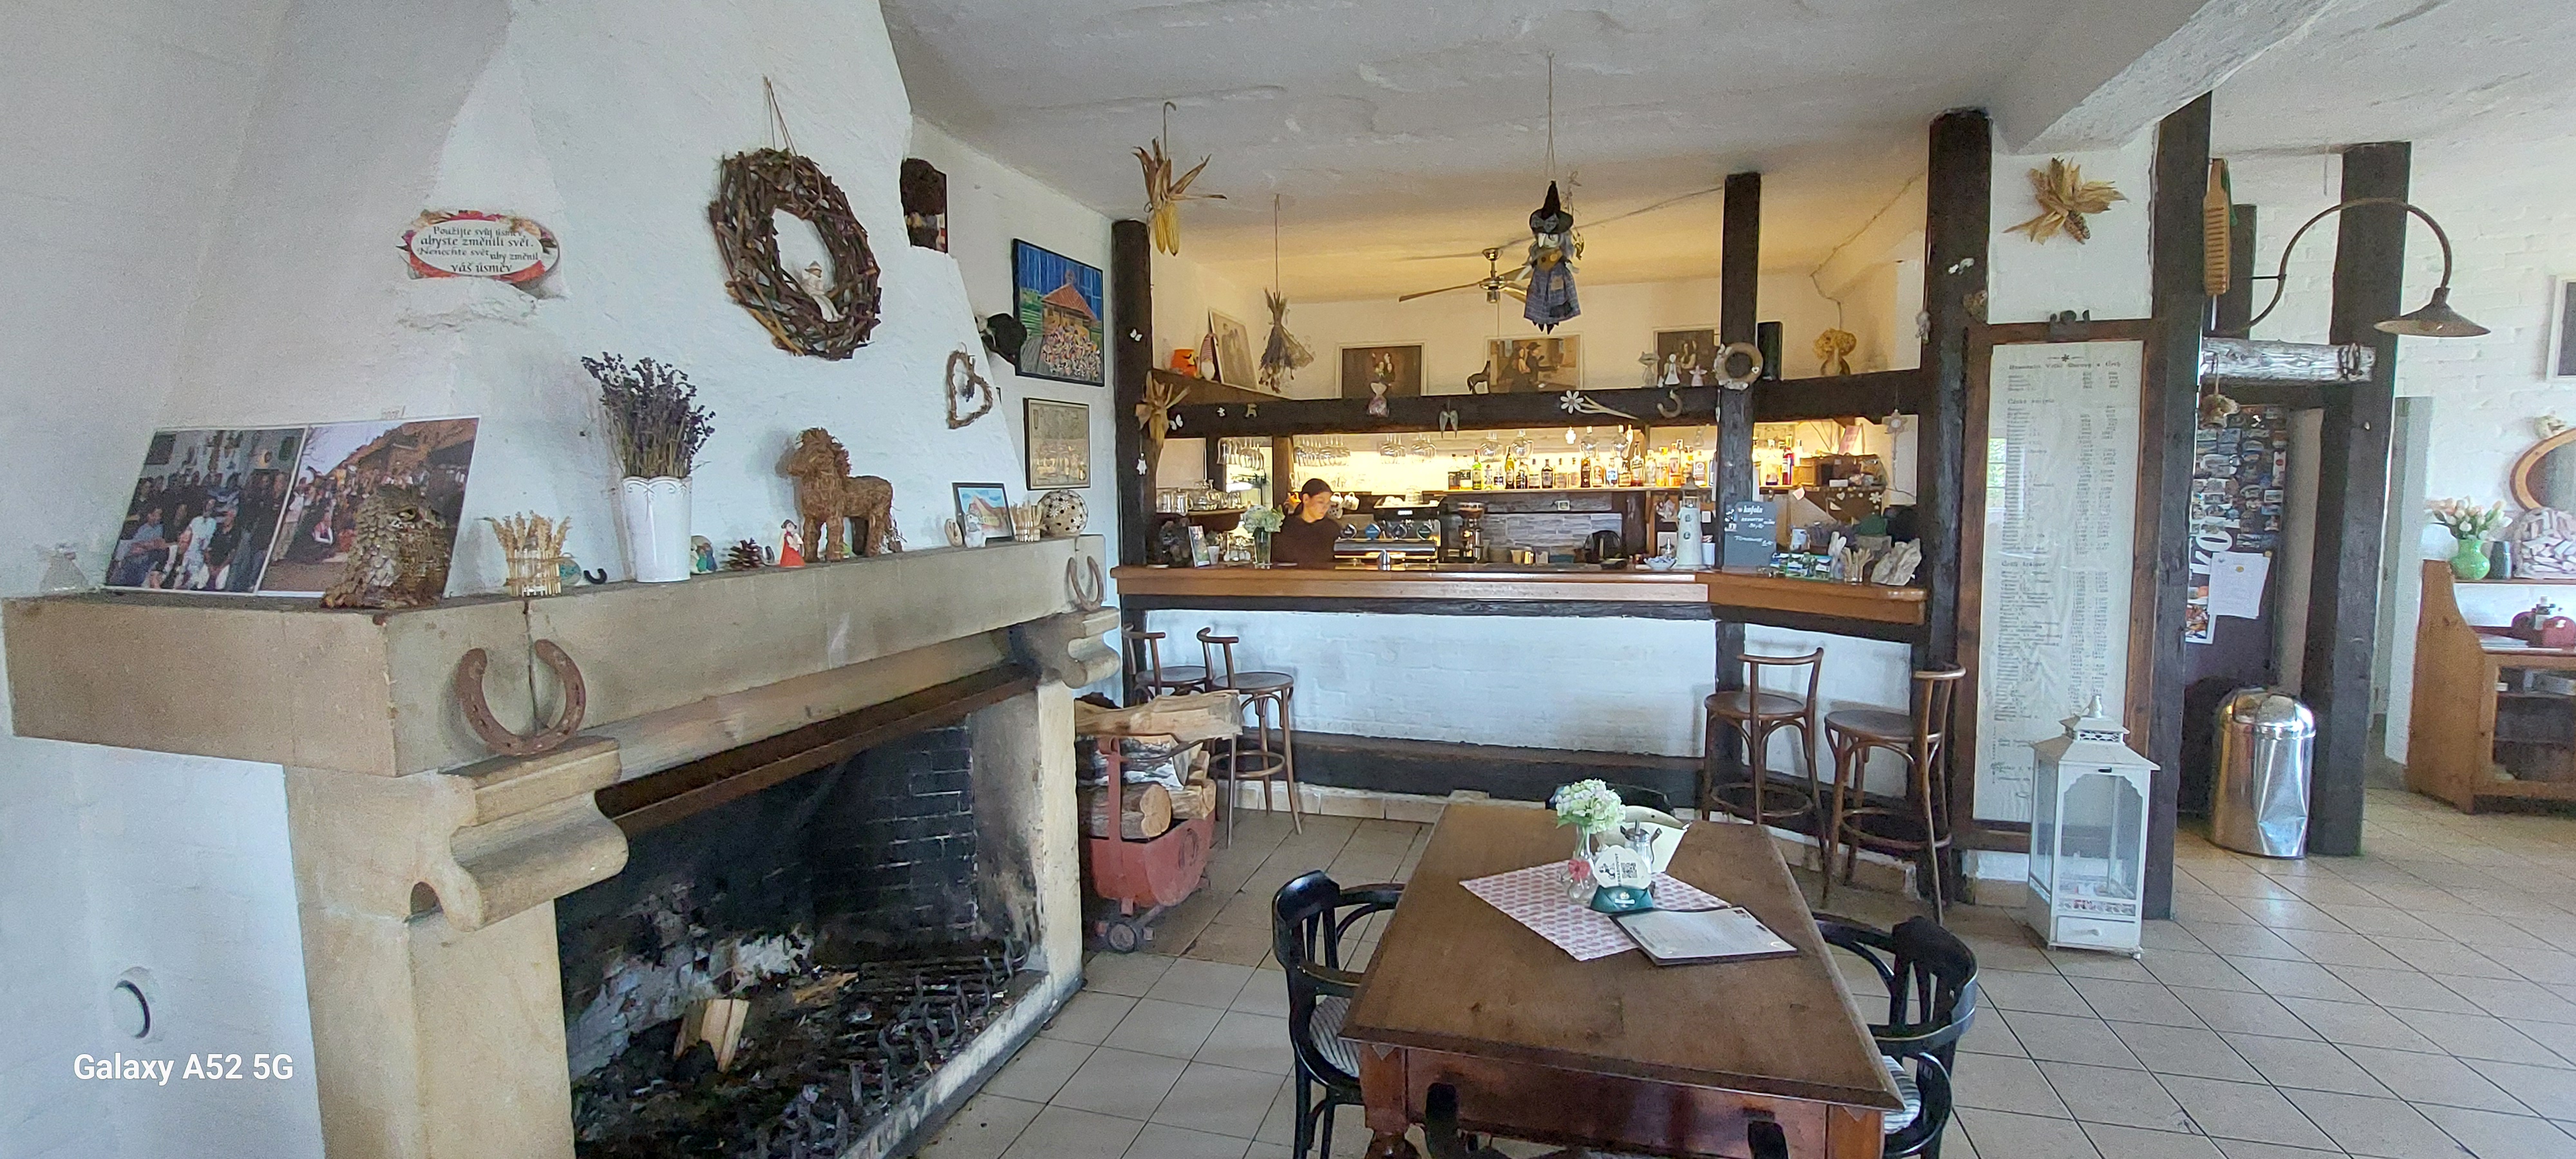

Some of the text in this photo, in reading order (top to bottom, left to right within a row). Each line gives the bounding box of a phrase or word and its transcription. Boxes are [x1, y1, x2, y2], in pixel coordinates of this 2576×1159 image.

[433, 226, 471, 238] Použijte
[475, 227, 493, 238] svůj
[421, 235, 533, 249] abyste změnili svět.
[417, 247, 467, 256] Nenechte
[490, 252, 506, 263] aby
[509, 252, 538, 261] změnil
[451, 262, 512, 273] váš úsměv
